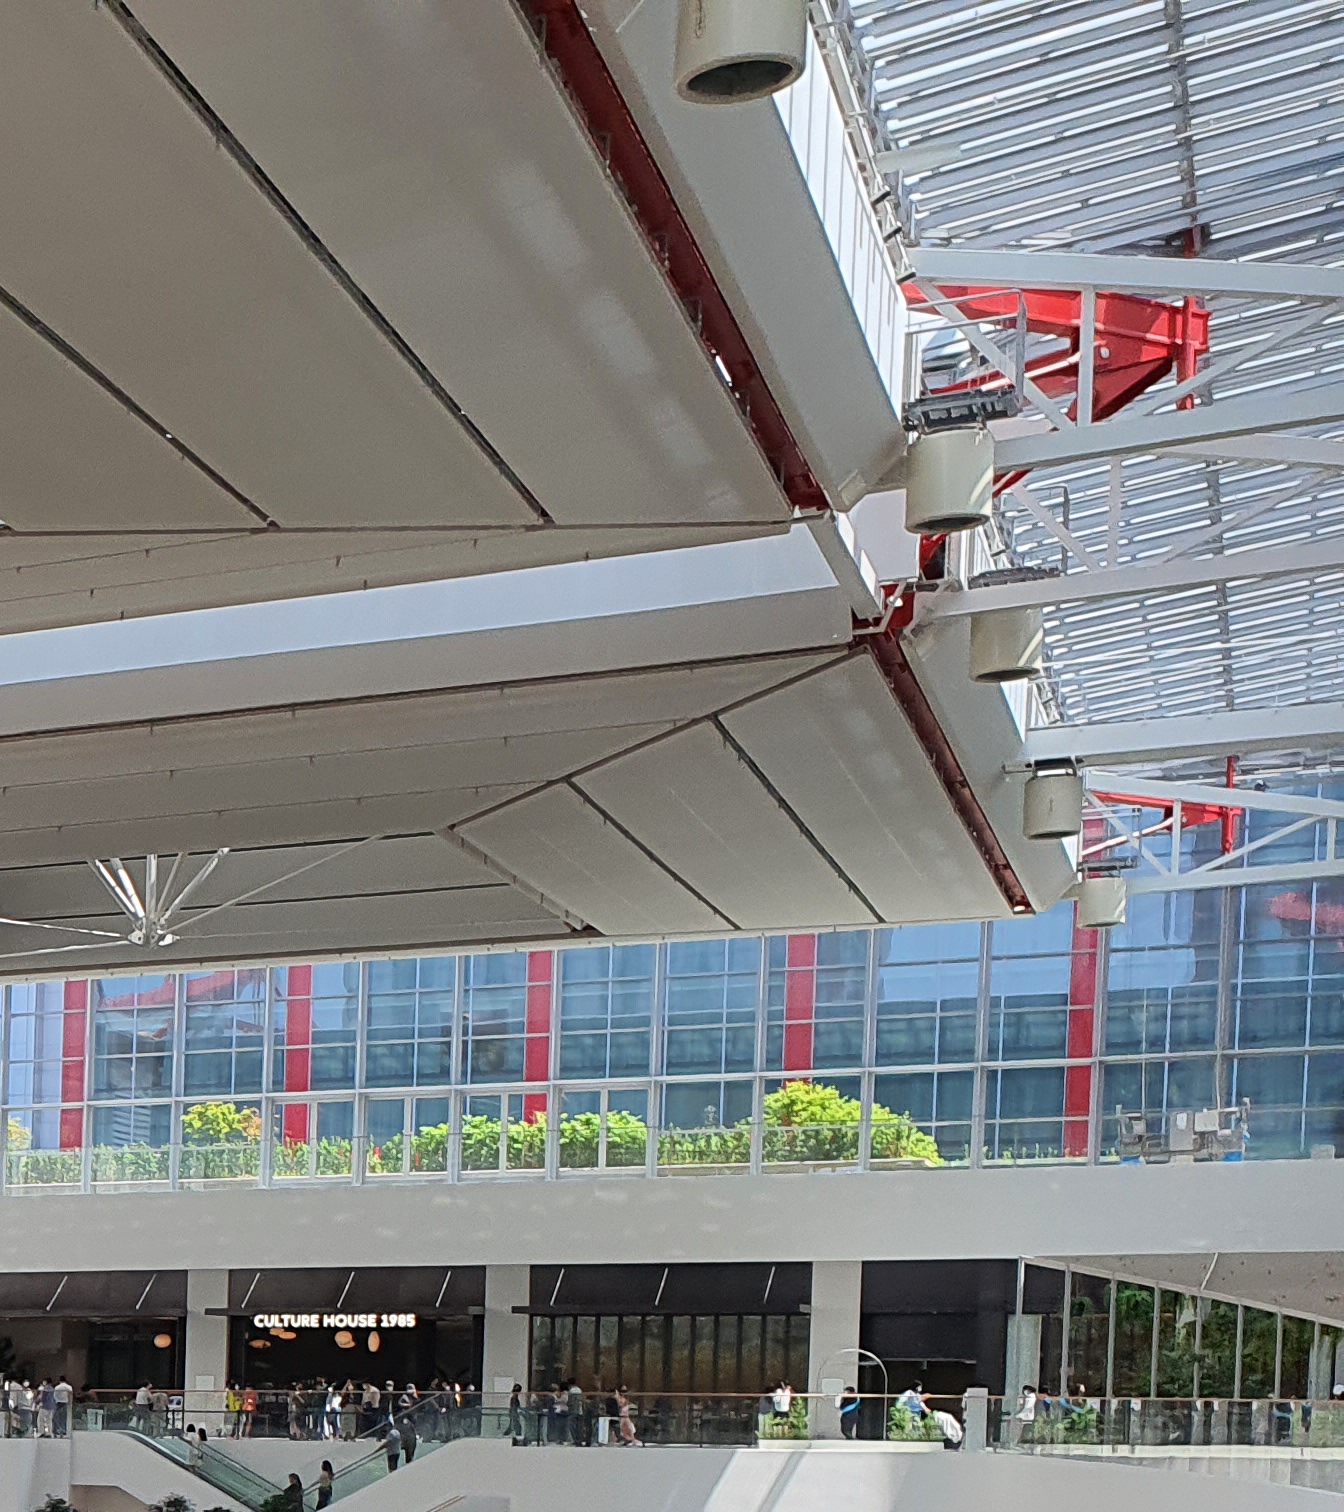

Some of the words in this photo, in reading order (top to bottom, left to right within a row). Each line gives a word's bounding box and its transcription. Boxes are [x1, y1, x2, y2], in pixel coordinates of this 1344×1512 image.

[253, 1314, 319, 1328] CULTURE
[323, 1314, 376, 1328] HOUSE
[380, 1314, 416, 1328] 1985
